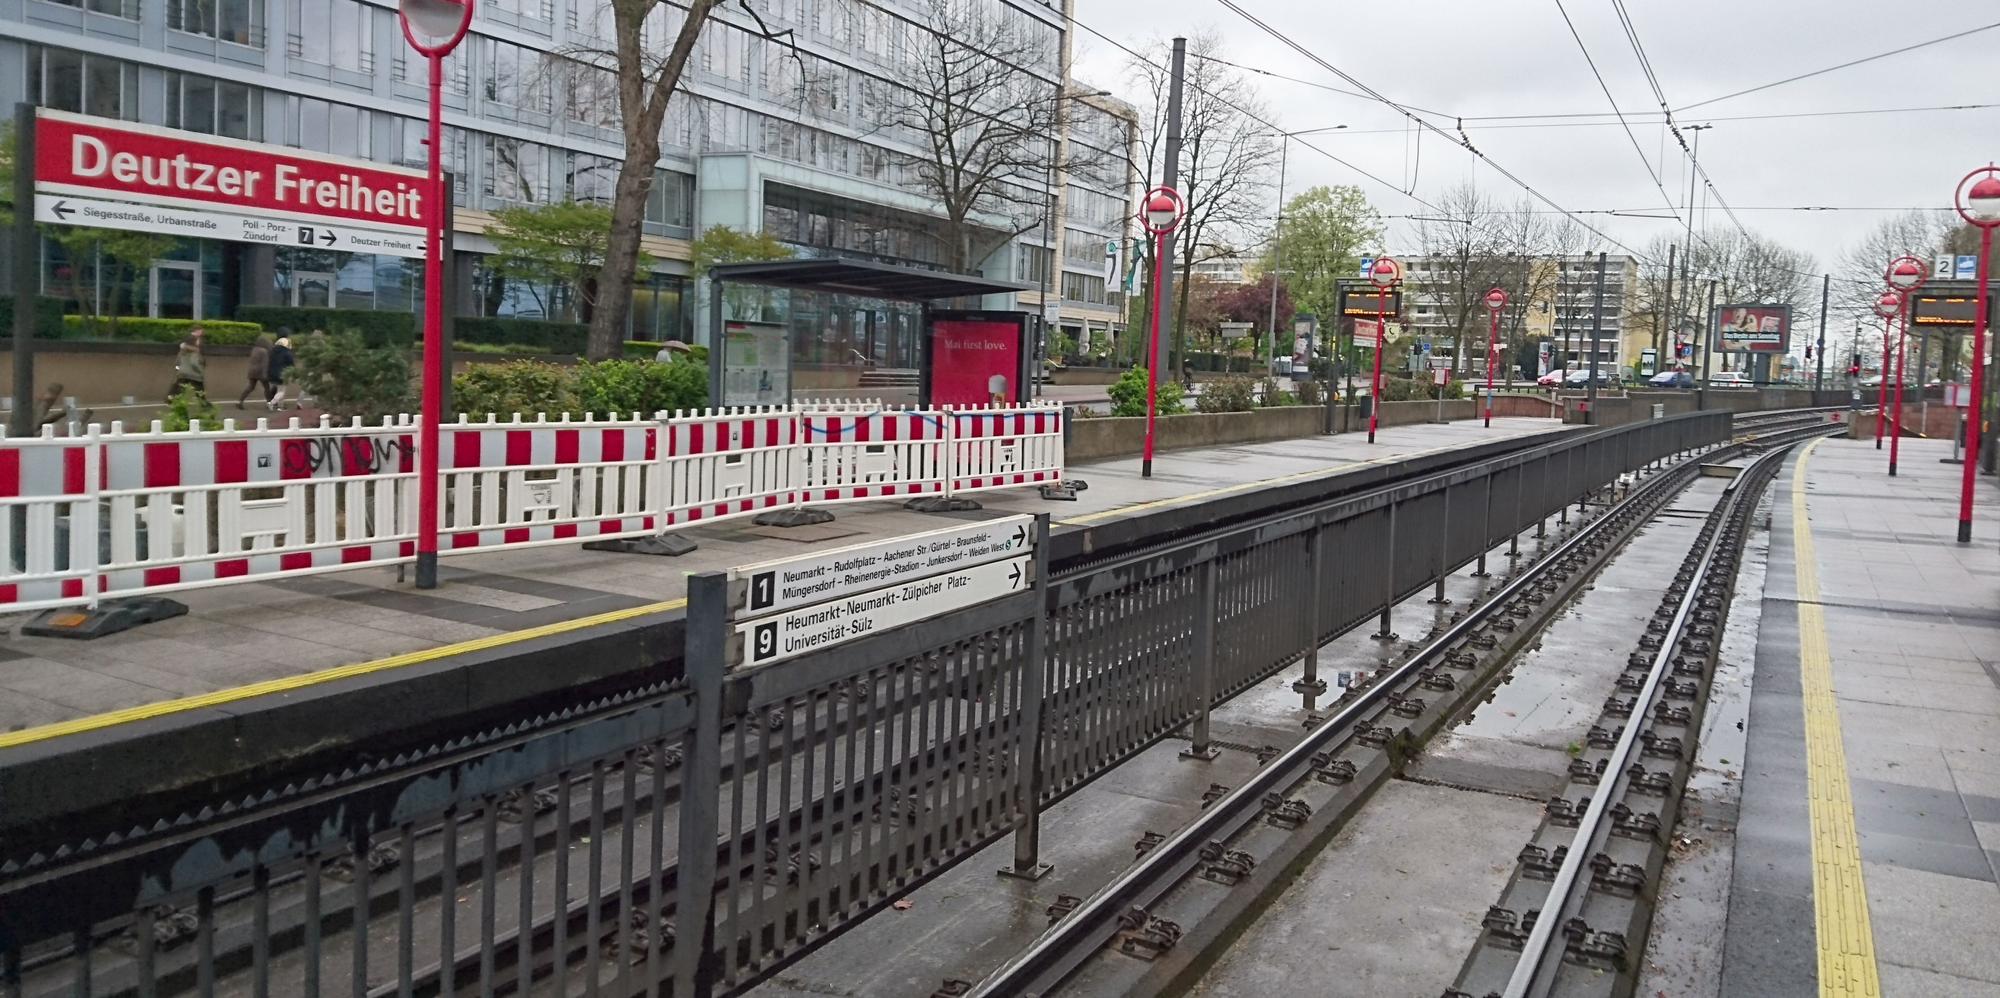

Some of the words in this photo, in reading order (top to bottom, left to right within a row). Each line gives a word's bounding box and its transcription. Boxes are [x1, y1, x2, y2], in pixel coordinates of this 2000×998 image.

[72, 133, 260, 198] Deutzer
[275, 164, 421, 219] Freiheit
[157, 215, 217, 230] Urbanstraße
[243, 220, 259, 229] Poll
[267, 222, 286, 231] Porz
[243, 230, 278, 242] Zündorf
[301, 230, 311, 240] 7
[351, 235, 381, 247] Deutzer
[383, 239, 412, 250] Freiheit
[1939, 260, 1950, 273] 2
[963, 339, 981, 349] first
[984, 340, 1007, 350] love.
[783, 565, 825, 583] Neumarkt
[834, 557, 876, 573] Rudolfplatz
[884, 548, 915, 562] Aachener
[957, 532, 987, 547] Braunsfeld
[782, 578, 836, 600] Müngersdorf
[844, 560, 920, 586] Rheinenergie-Stadion
[926, 551, 962, 567] Junkersdorf
[968, 545, 990, 558] Weiden
[990, 542, 1005, 555] West
[759, 578, 768, 603] 1
[759, 628, 772, 655] 9
[785, 617, 873, 653] Universität-Sülz
